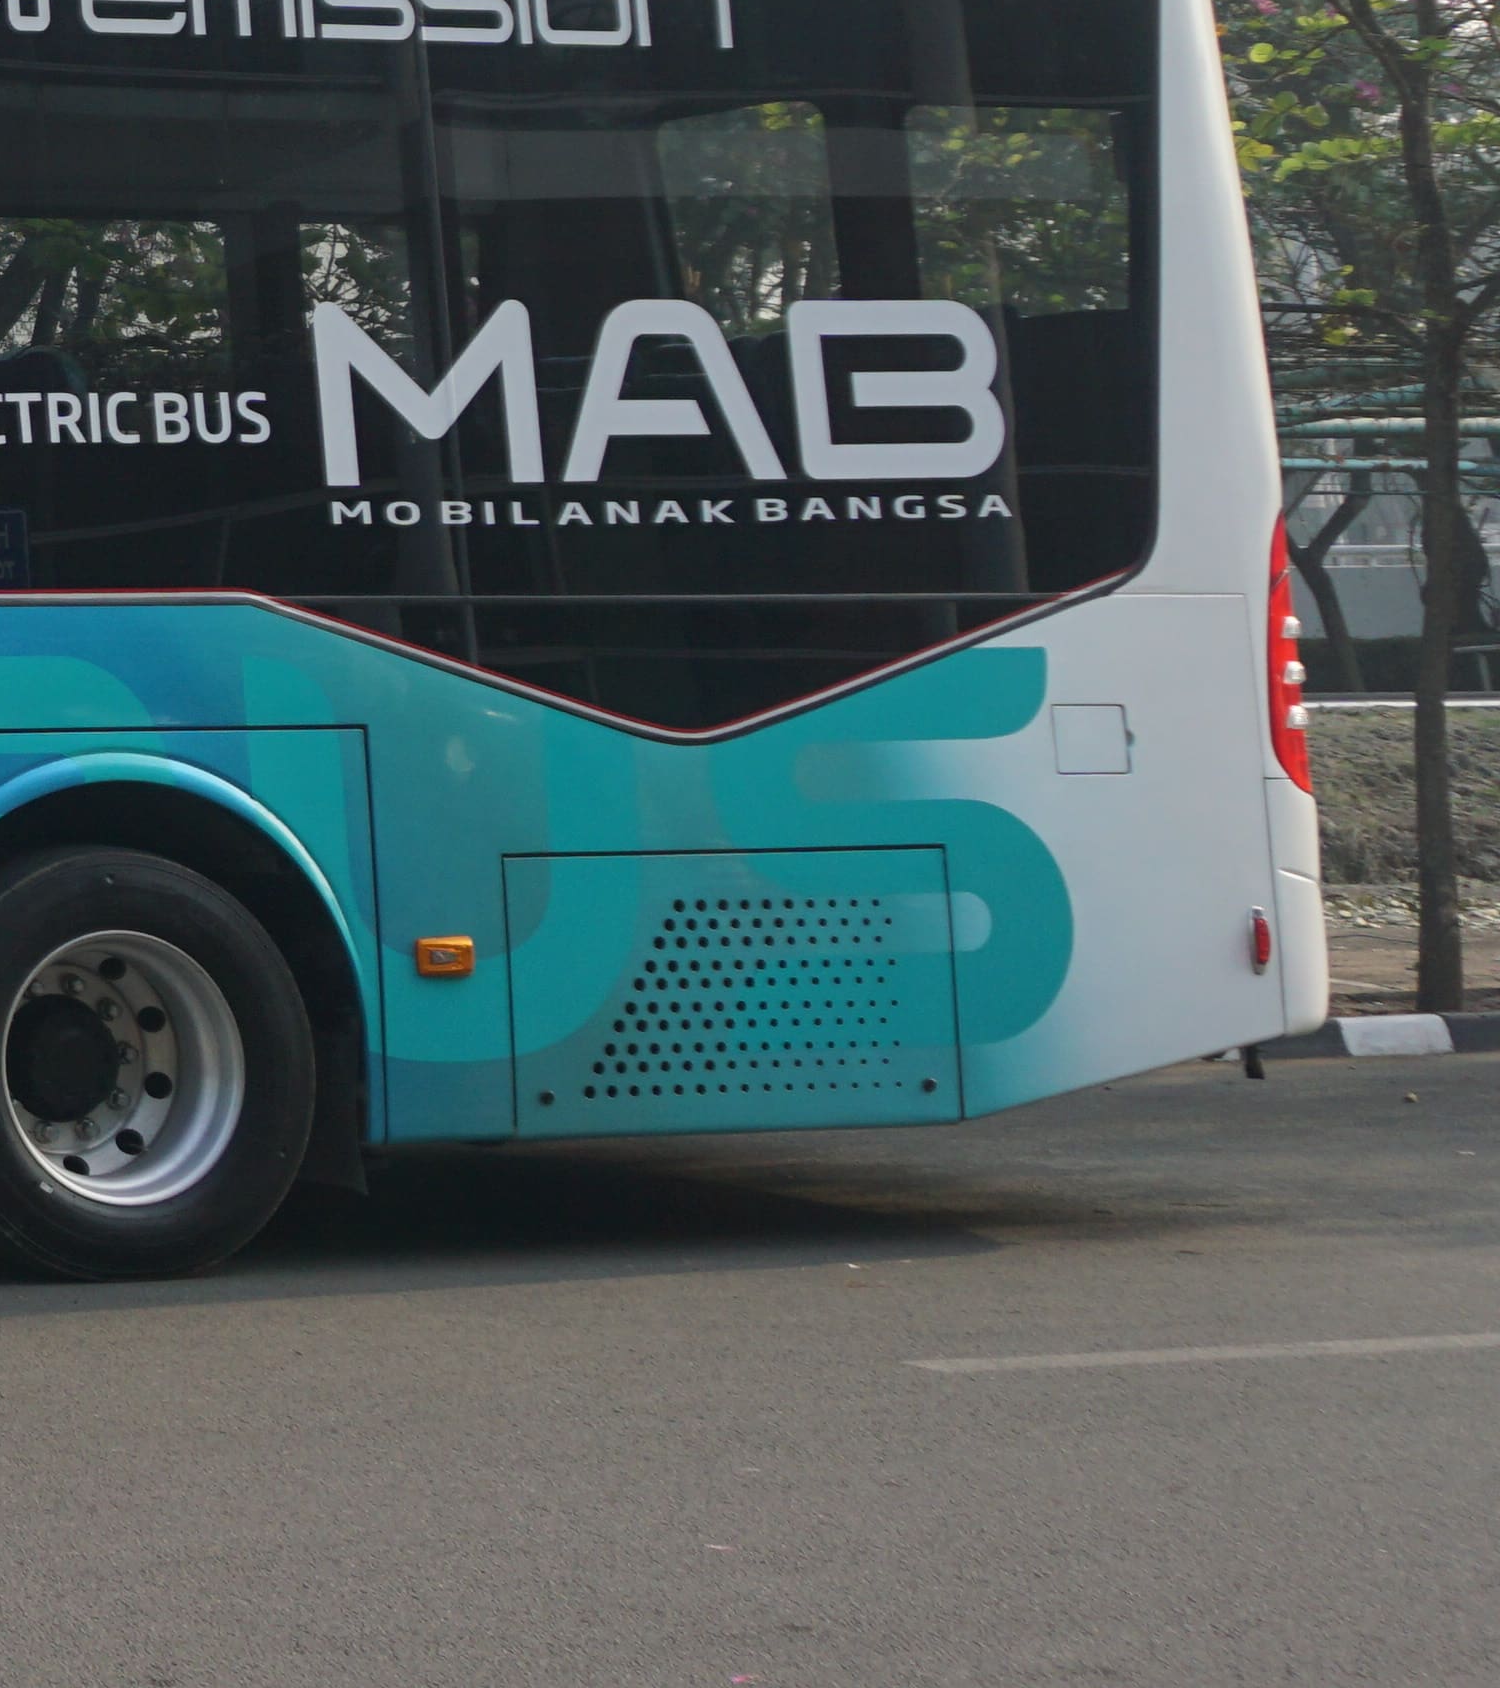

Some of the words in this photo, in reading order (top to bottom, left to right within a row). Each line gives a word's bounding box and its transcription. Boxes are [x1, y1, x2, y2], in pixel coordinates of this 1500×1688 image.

[154, 391, 271, 444] BUS
[313, 299, 1006, 487] MAB
[332, 500, 540, 526] MOBIL
[558, 499, 736, 525] ANAK
[757, 495, 1013, 522] BANGSA
